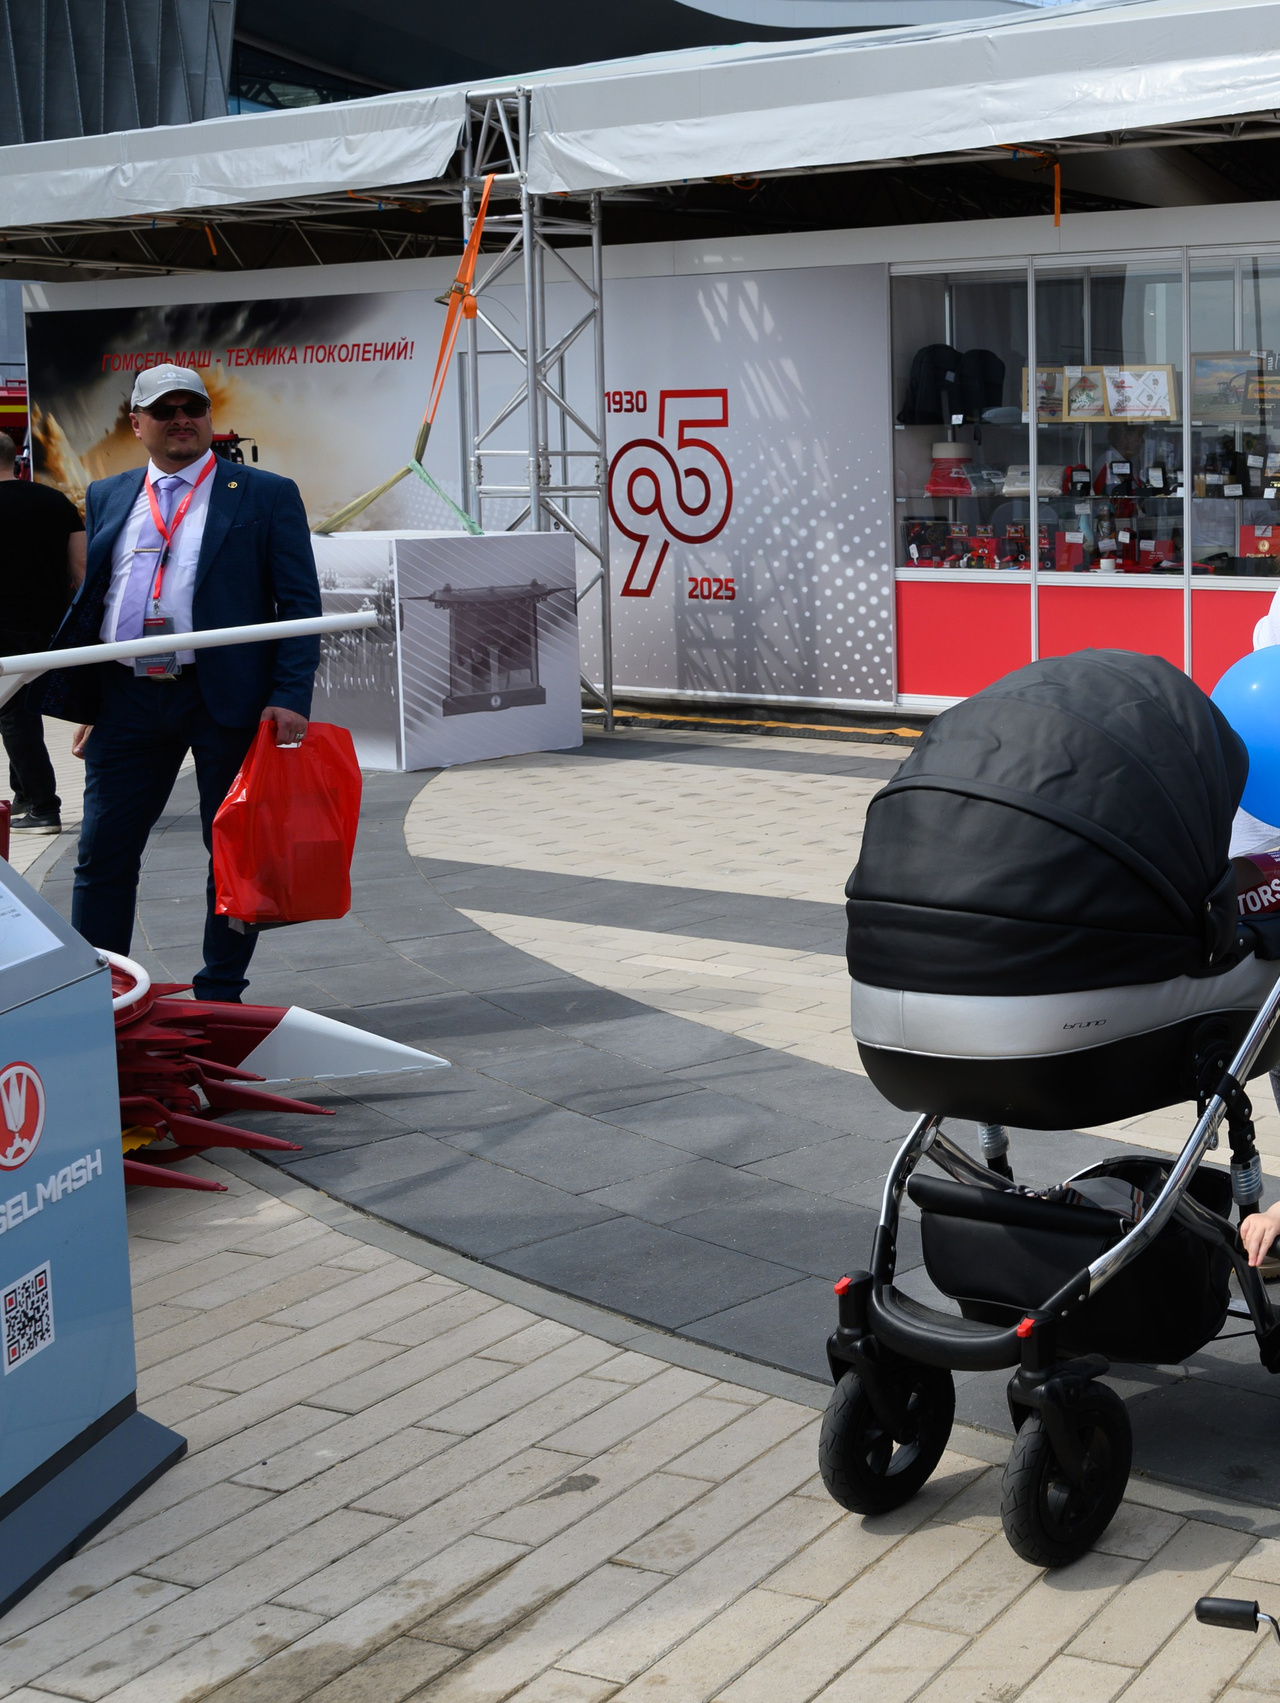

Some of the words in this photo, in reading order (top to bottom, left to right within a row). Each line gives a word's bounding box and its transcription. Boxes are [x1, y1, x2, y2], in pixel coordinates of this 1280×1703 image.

[226, 346, 298, 367] ТЕХНИКА
[302, 337, 415, 364] ПОКОЛЕНИЙ!
[604, 390, 648, 413] 1930
[688, 577, 736, 600] 2025
[1063, 1019, 1107, 1030] bruno
